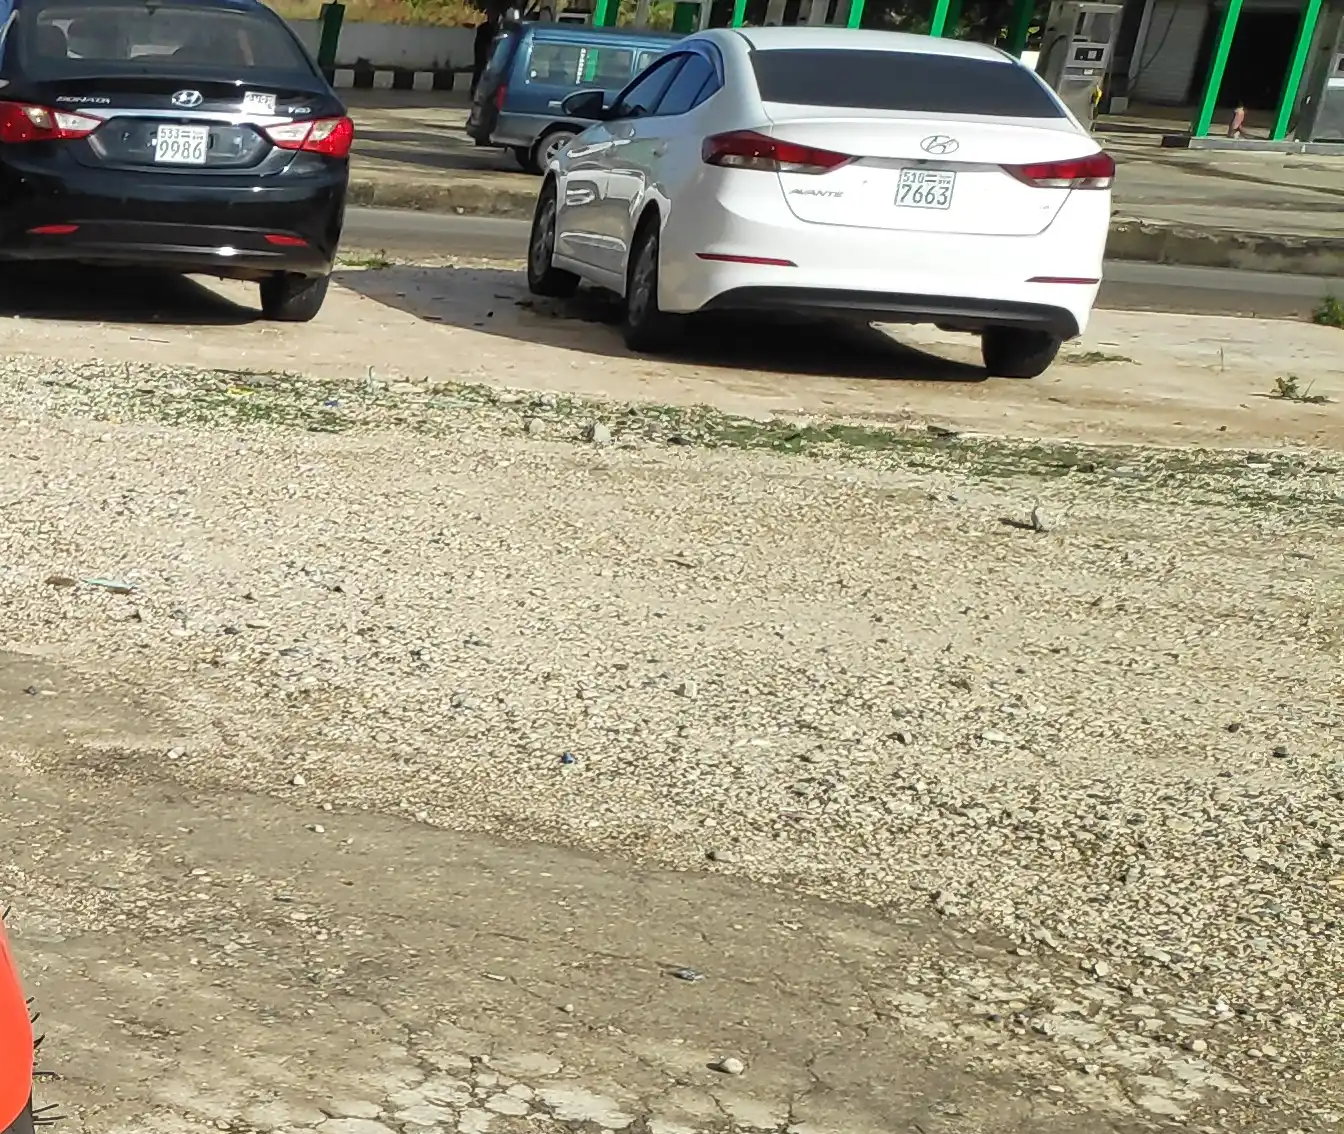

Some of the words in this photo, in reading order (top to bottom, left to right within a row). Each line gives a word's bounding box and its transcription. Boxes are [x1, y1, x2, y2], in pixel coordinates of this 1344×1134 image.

[160, 128, 180, 139] 533
[159, 140, 203, 160] 9986
[902, 171, 925, 183] 510
[899, 183, 950, 205] 7663
